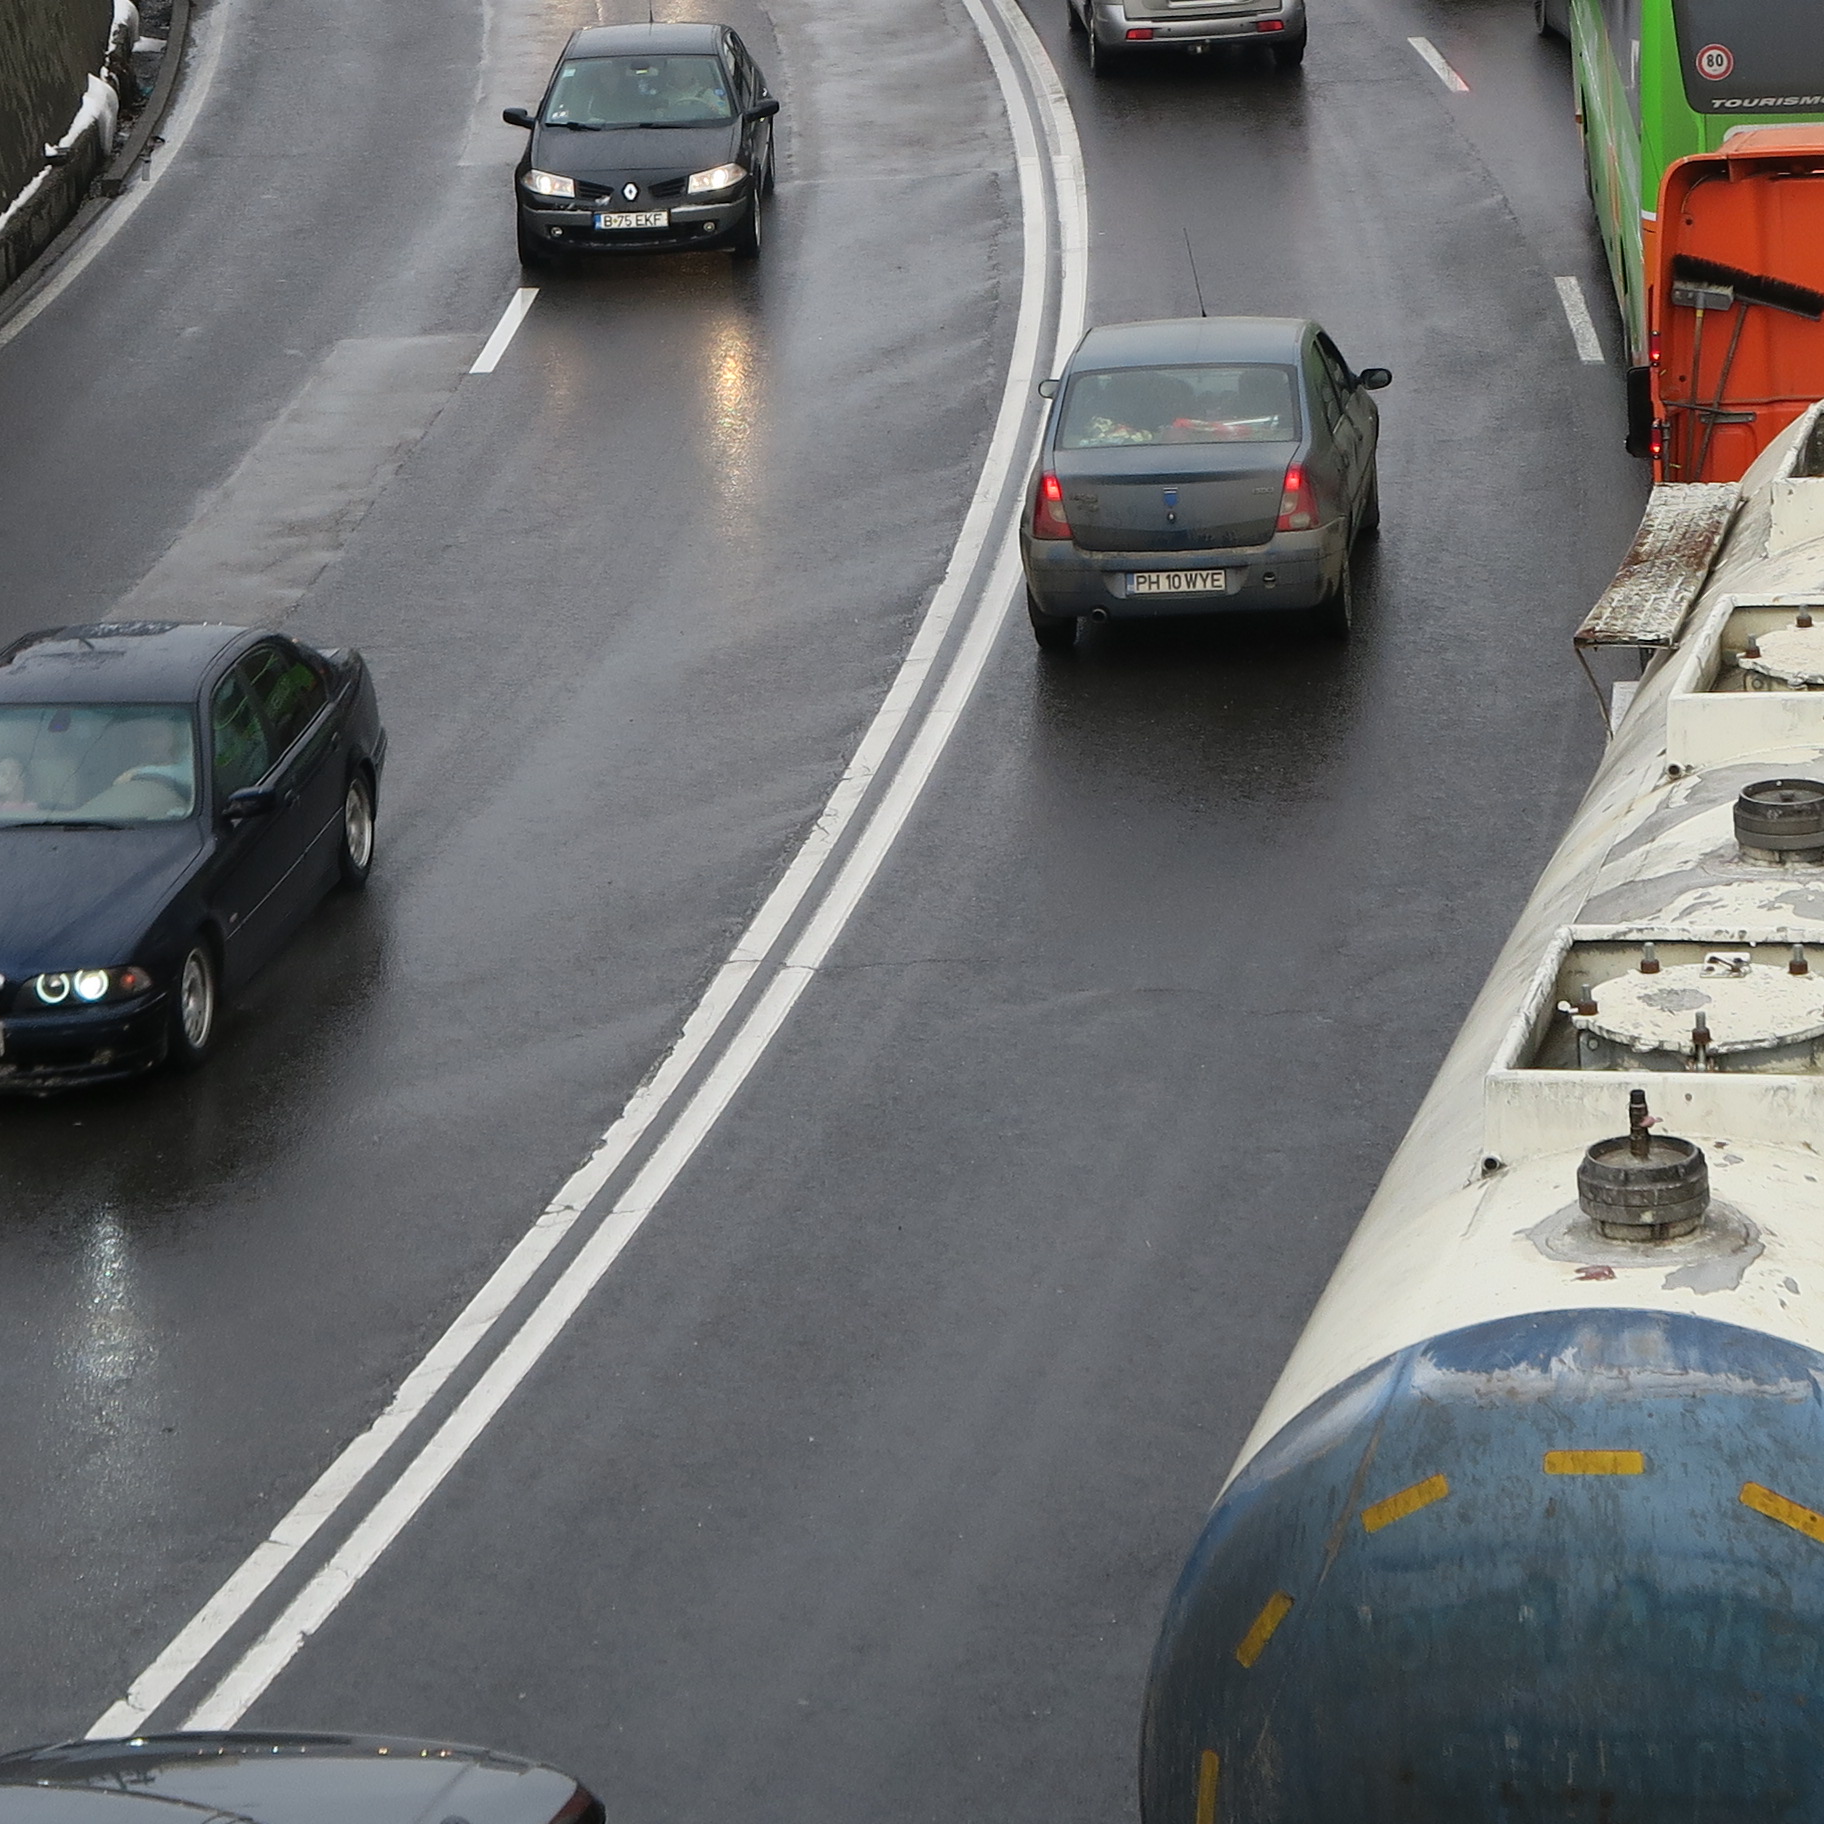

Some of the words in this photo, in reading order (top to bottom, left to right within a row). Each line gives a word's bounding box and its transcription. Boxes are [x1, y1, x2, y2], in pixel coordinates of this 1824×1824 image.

[1706, 53, 1724, 67] 80
[604, 215, 613, 227] B
[617, 215, 632, 227] 75
[635, 213, 662, 226] EKF
[1136, 575, 1160, 591] PH
[1166, 574, 1181, 590] 10
[1185, 572, 1223, 589] WYE
